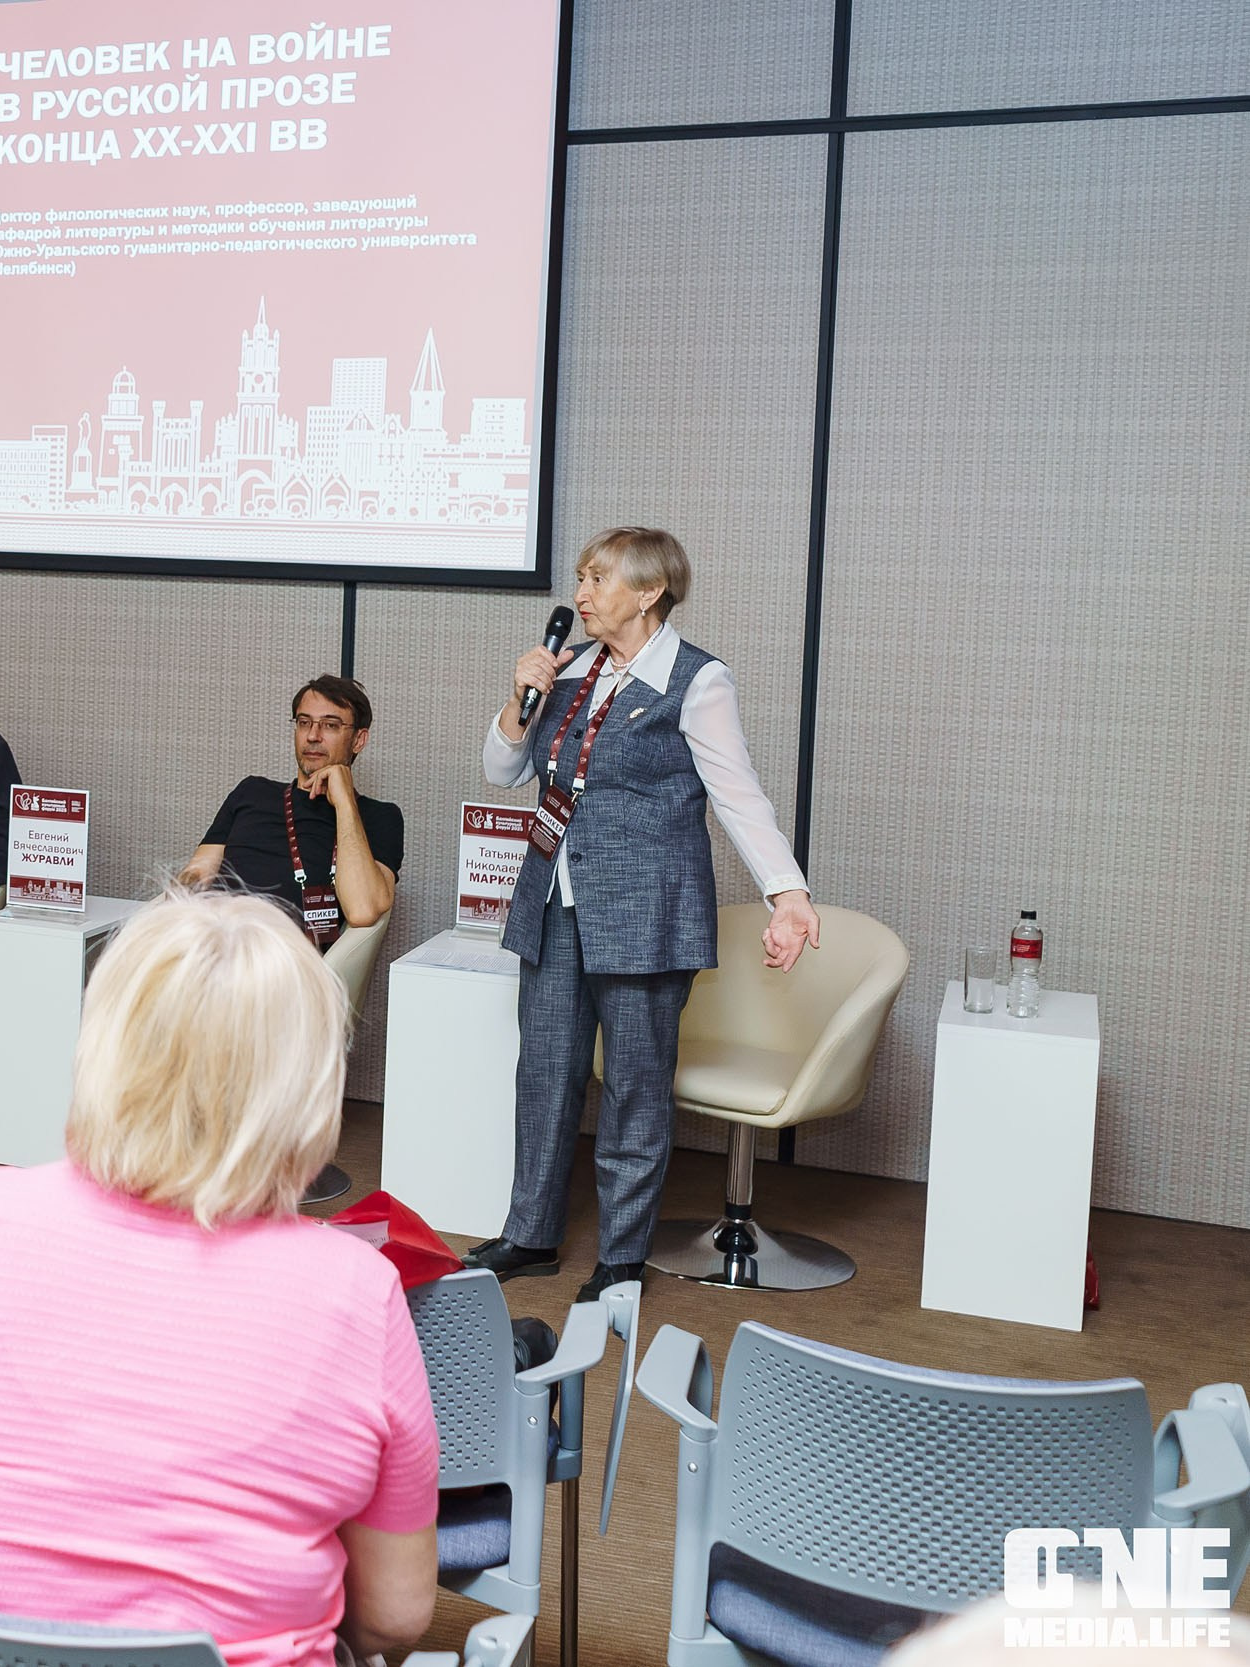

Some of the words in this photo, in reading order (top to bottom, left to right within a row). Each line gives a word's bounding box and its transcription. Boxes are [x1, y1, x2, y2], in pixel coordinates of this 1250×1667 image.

[183, 37, 236, 69] НА
[249, 21, 392, 65] ВОЙНЕ
[32, 73, 208, 120] РУССКОЙ
[221, 71, 357, 109] ПРОЗЕ
[130, 121, 256, 159] XX-XXI
[269, 118, 328, 152] ВВ
[45, 205, 169, 223] филологических
[172, 205, 210, 219] наук,
[215, 200, 308, 218] профессор,
[313, 194, 417, 213] заведующий
[65, 223, 154, 241] литературы
[158, 225, 167, 235] и
[172, 220, 244, 236] методики
[249, 218, 325, 235] обучения
[329, 215, 428, 231] литературы
[124, 235, 357, 257] гуманитарно-педагогического
[361, 232, 477, 251] университета
[539, 810, 564, 833] СПИКЕР
[13, 841, 84, 855] Вячеславович
[28, 830, 69, 842] Евгений
[21, 853, 74, 866] ЖУРАВЛИ
[479, 847, 525, 861] Татьяна
[307, 910, 337, 919] СПИКЕР
